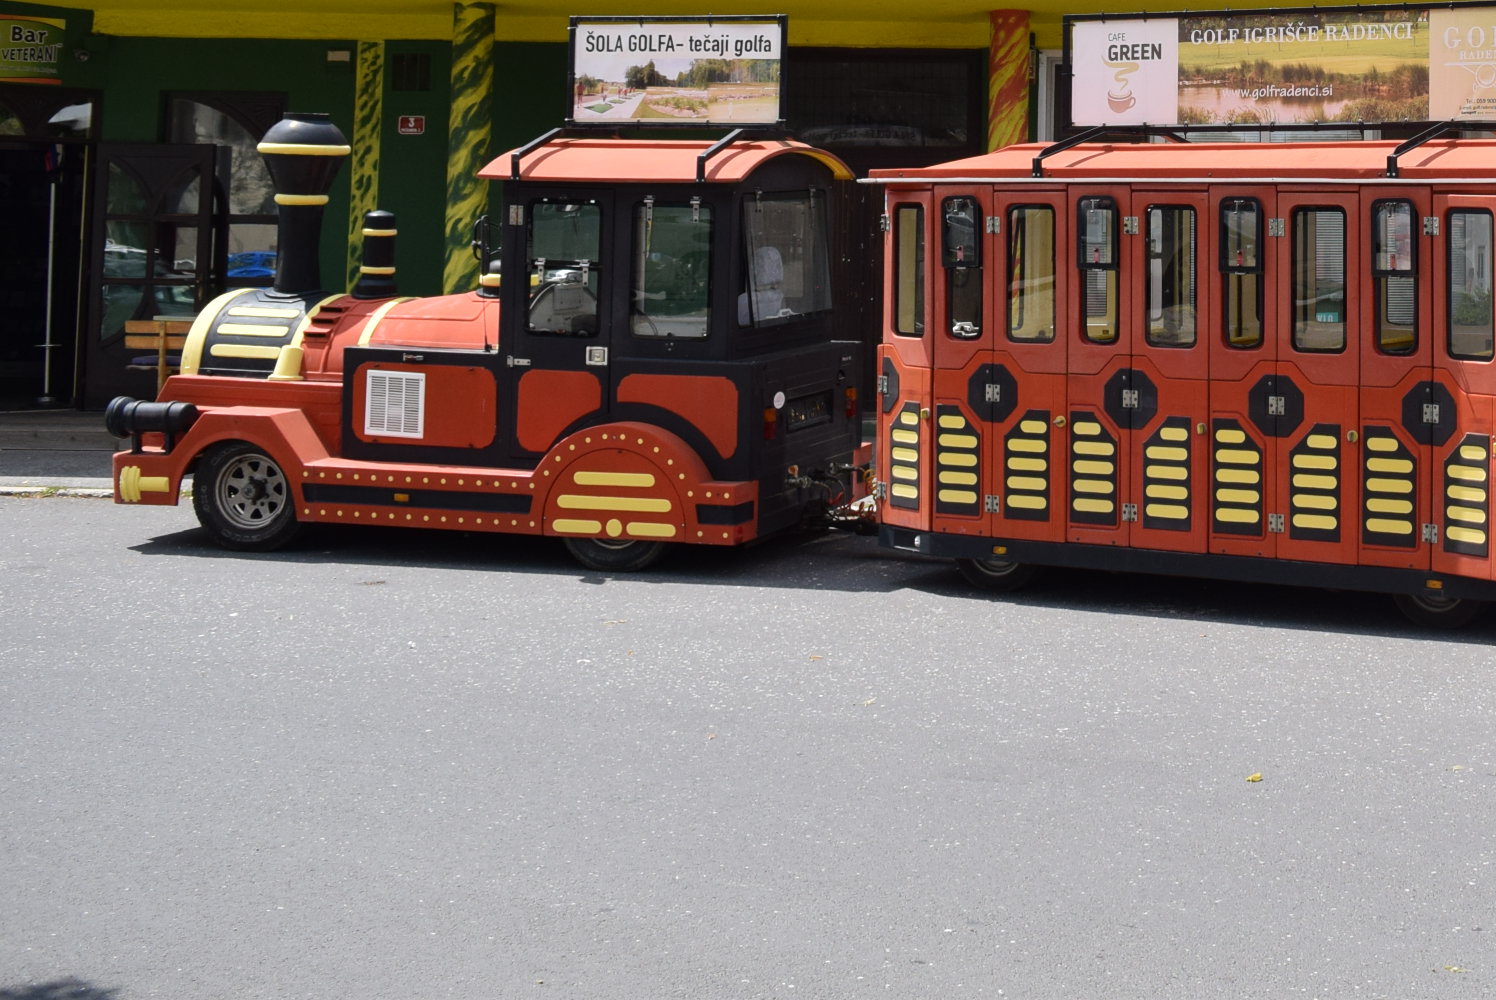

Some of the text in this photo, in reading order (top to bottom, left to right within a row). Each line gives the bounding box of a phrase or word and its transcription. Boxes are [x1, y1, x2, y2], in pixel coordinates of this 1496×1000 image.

[11, 25, 48, 44] Bar
[1107, 32, 1126, 42] CAFE
[1190, 22, 1413, 45] GOLF IGRIŠČE RADENCI
[585, 30, 623, 52] ŠOLA
[689, 34, 729, 56] tečaji
[734, 34, 772, 57] golfa
[1107, 43, 1162, 62] GREEN
[1, 45, 58, 62] VETERANI
[1222, 83, 1333, 100] www.golfradenci.si
[408, 117, 415, 128] 3
